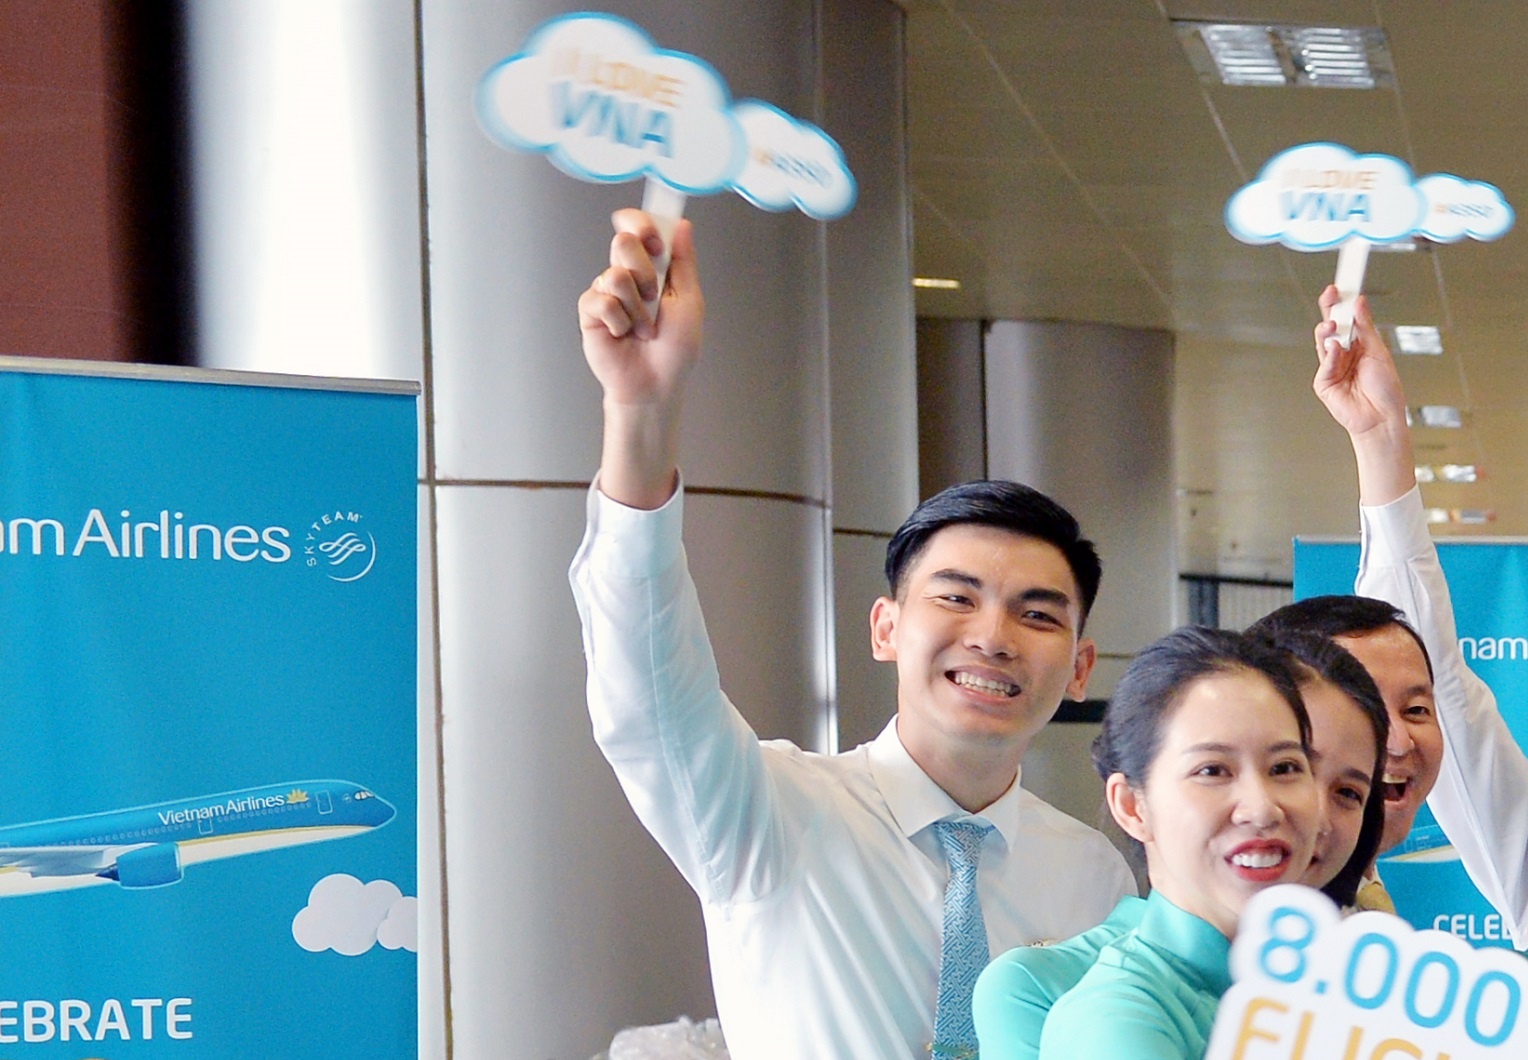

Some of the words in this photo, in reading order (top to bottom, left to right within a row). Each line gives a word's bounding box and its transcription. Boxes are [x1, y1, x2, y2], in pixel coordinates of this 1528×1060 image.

[551, 81, 675, 158] VNA
[1282, 190, 1371, 222] VNA
[72, 508, 292, 563] Airlines
[304, 511, 362, 568] SKYTEAM
[158, 804, 227, 827] Vietnam
[226, 793, 285, 815] Airlines
